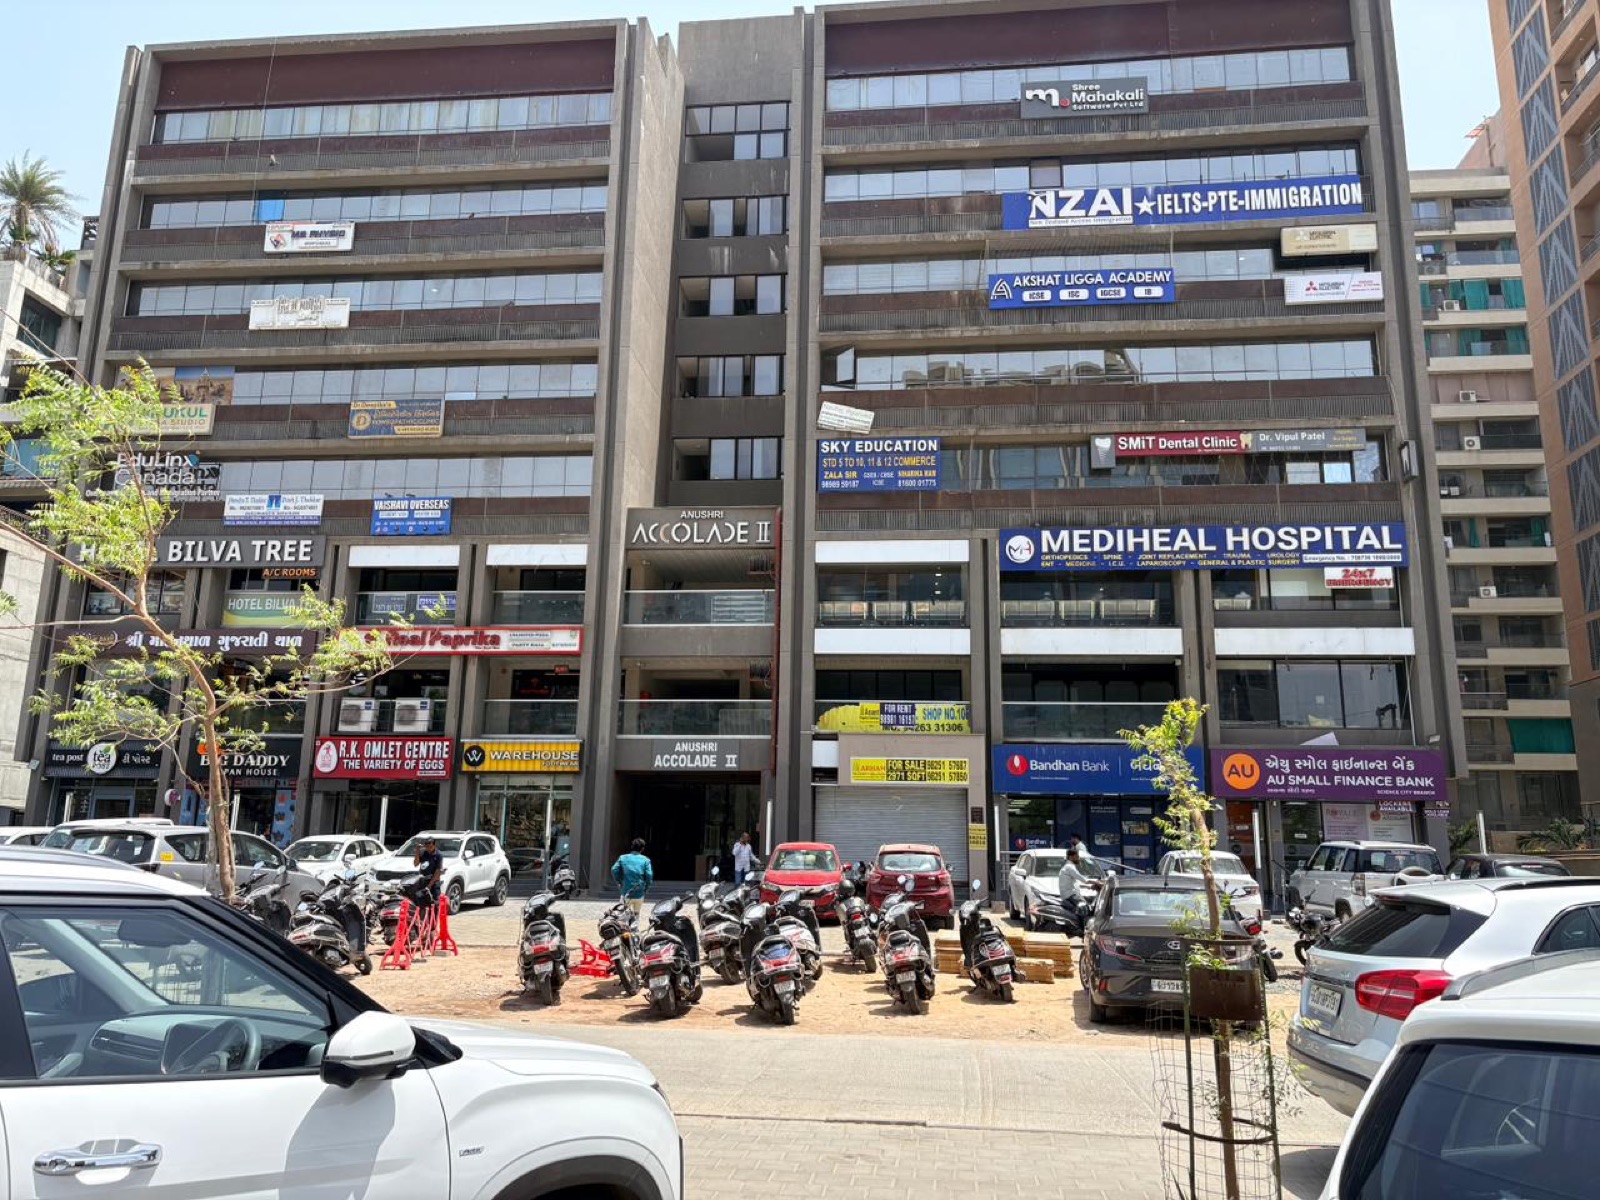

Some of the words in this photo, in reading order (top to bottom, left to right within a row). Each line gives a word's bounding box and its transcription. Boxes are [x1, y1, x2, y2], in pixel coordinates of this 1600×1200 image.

[1072, 88, 1144, 103] Mahakali
[1073, 103, 1111, 111] Software
[1029, 188, 1131, 219] NZAI
[1157, 182, 1362, 215] IELTS-PTE-IMMIGRATION
[1013, 274, 1060, 287] AKSHAT
[1065, 273, 1104, 286] LIGGA
[1109, 270, 1171, 284] ACADEMY
[821, 440, 850, 453] SKY
[855, 440, 938, 452] EDUCATION
[1159, 438, 1199, 450] Dental
[1202, 436, 1238, 449] Clinic
[1259, 433, 1272, 441] Dr.
[1275, 433, 1298, 442] Vipul
[1301, 432, 1326, 441] Patel
[822, 458, 837, 467] STD
[845, 458, 855, 467] TO
[868, 457, 875, 467] 11
[877, 457, 882, 466] &
[884, 457, 893, 466] 12
[894, 456, 936, 466] COMMERCE
[824, 470, 843, 479] ZALA
[845, 470, 858, 479] SIR
[410, 499, 450, 510] OVERSEAS
[680, 510, 724, 519] ANUSHRI
[632, 521, 749, 544] ACCOLADE
[1041, 528, 1216, 553] MEDIHEAL
[1226, 526, 1402, 551] HOSPITAL
[168, 539, 240, 562] BILVA
[251, 539, 313, 562] TREE
[1158, 552, 1207, 560] REPLACEMENT
[1136, 559, 1186, 567] LAPAROSCOPY
[1268, 558, 1300, 566] SURGERY
[263, 568, 280, 578] A/C
[282, 568, 317, 578] ROOMS
[228, 598, 263, 610] HOTEL
[428, 630, 501, 651] Paprika
[884, 704, 896, 713] FOR
[897, 704, 912, 713] RENT
[923, 707, 942, 721] SHOP
[945, 707, 956, 720] NO.
[934, 723, 963, 732] 31306
[339, 741, 360, 759] R.K.
[364, 740, 401, 758] OMLET
[405, 740, 450, 759] CENTRE
[675, 742, 717, 752] ANUSHRI
[52, 753, 65, 762] tea
[66, 753, 84, 764] post
[93, 750, 111, 762] tea
[489, 750, 579, 761] WAREHOUSE
[654, 754, 717, 767] ACCOLADE
[200, 755, 229, 767] BG
[230, 754, 291, 770] DADDY
[343, 760, 361, 770] THE
[363, 760, 401, 770] VARIETY
[404, 760, 417, 769] OF
[419, 759, 444, 769] EGGS
[889, 760, 903, 770] FOR
[905, 760, 925, 770] SALE
[1030, 759, 1080, 771] Bandhan
[1082, 759, 1110, 771] Bank
[246, 768, 277, 776] HOUSE
[1227, 764, 1254, 778] AU
[1267, 775, 1285, 785] AU
[1288, 775, 1331, 786] SMALL
[1334, 775, 1393, 786] FINANCE
[1396, 776, 1435, 787] BANK
